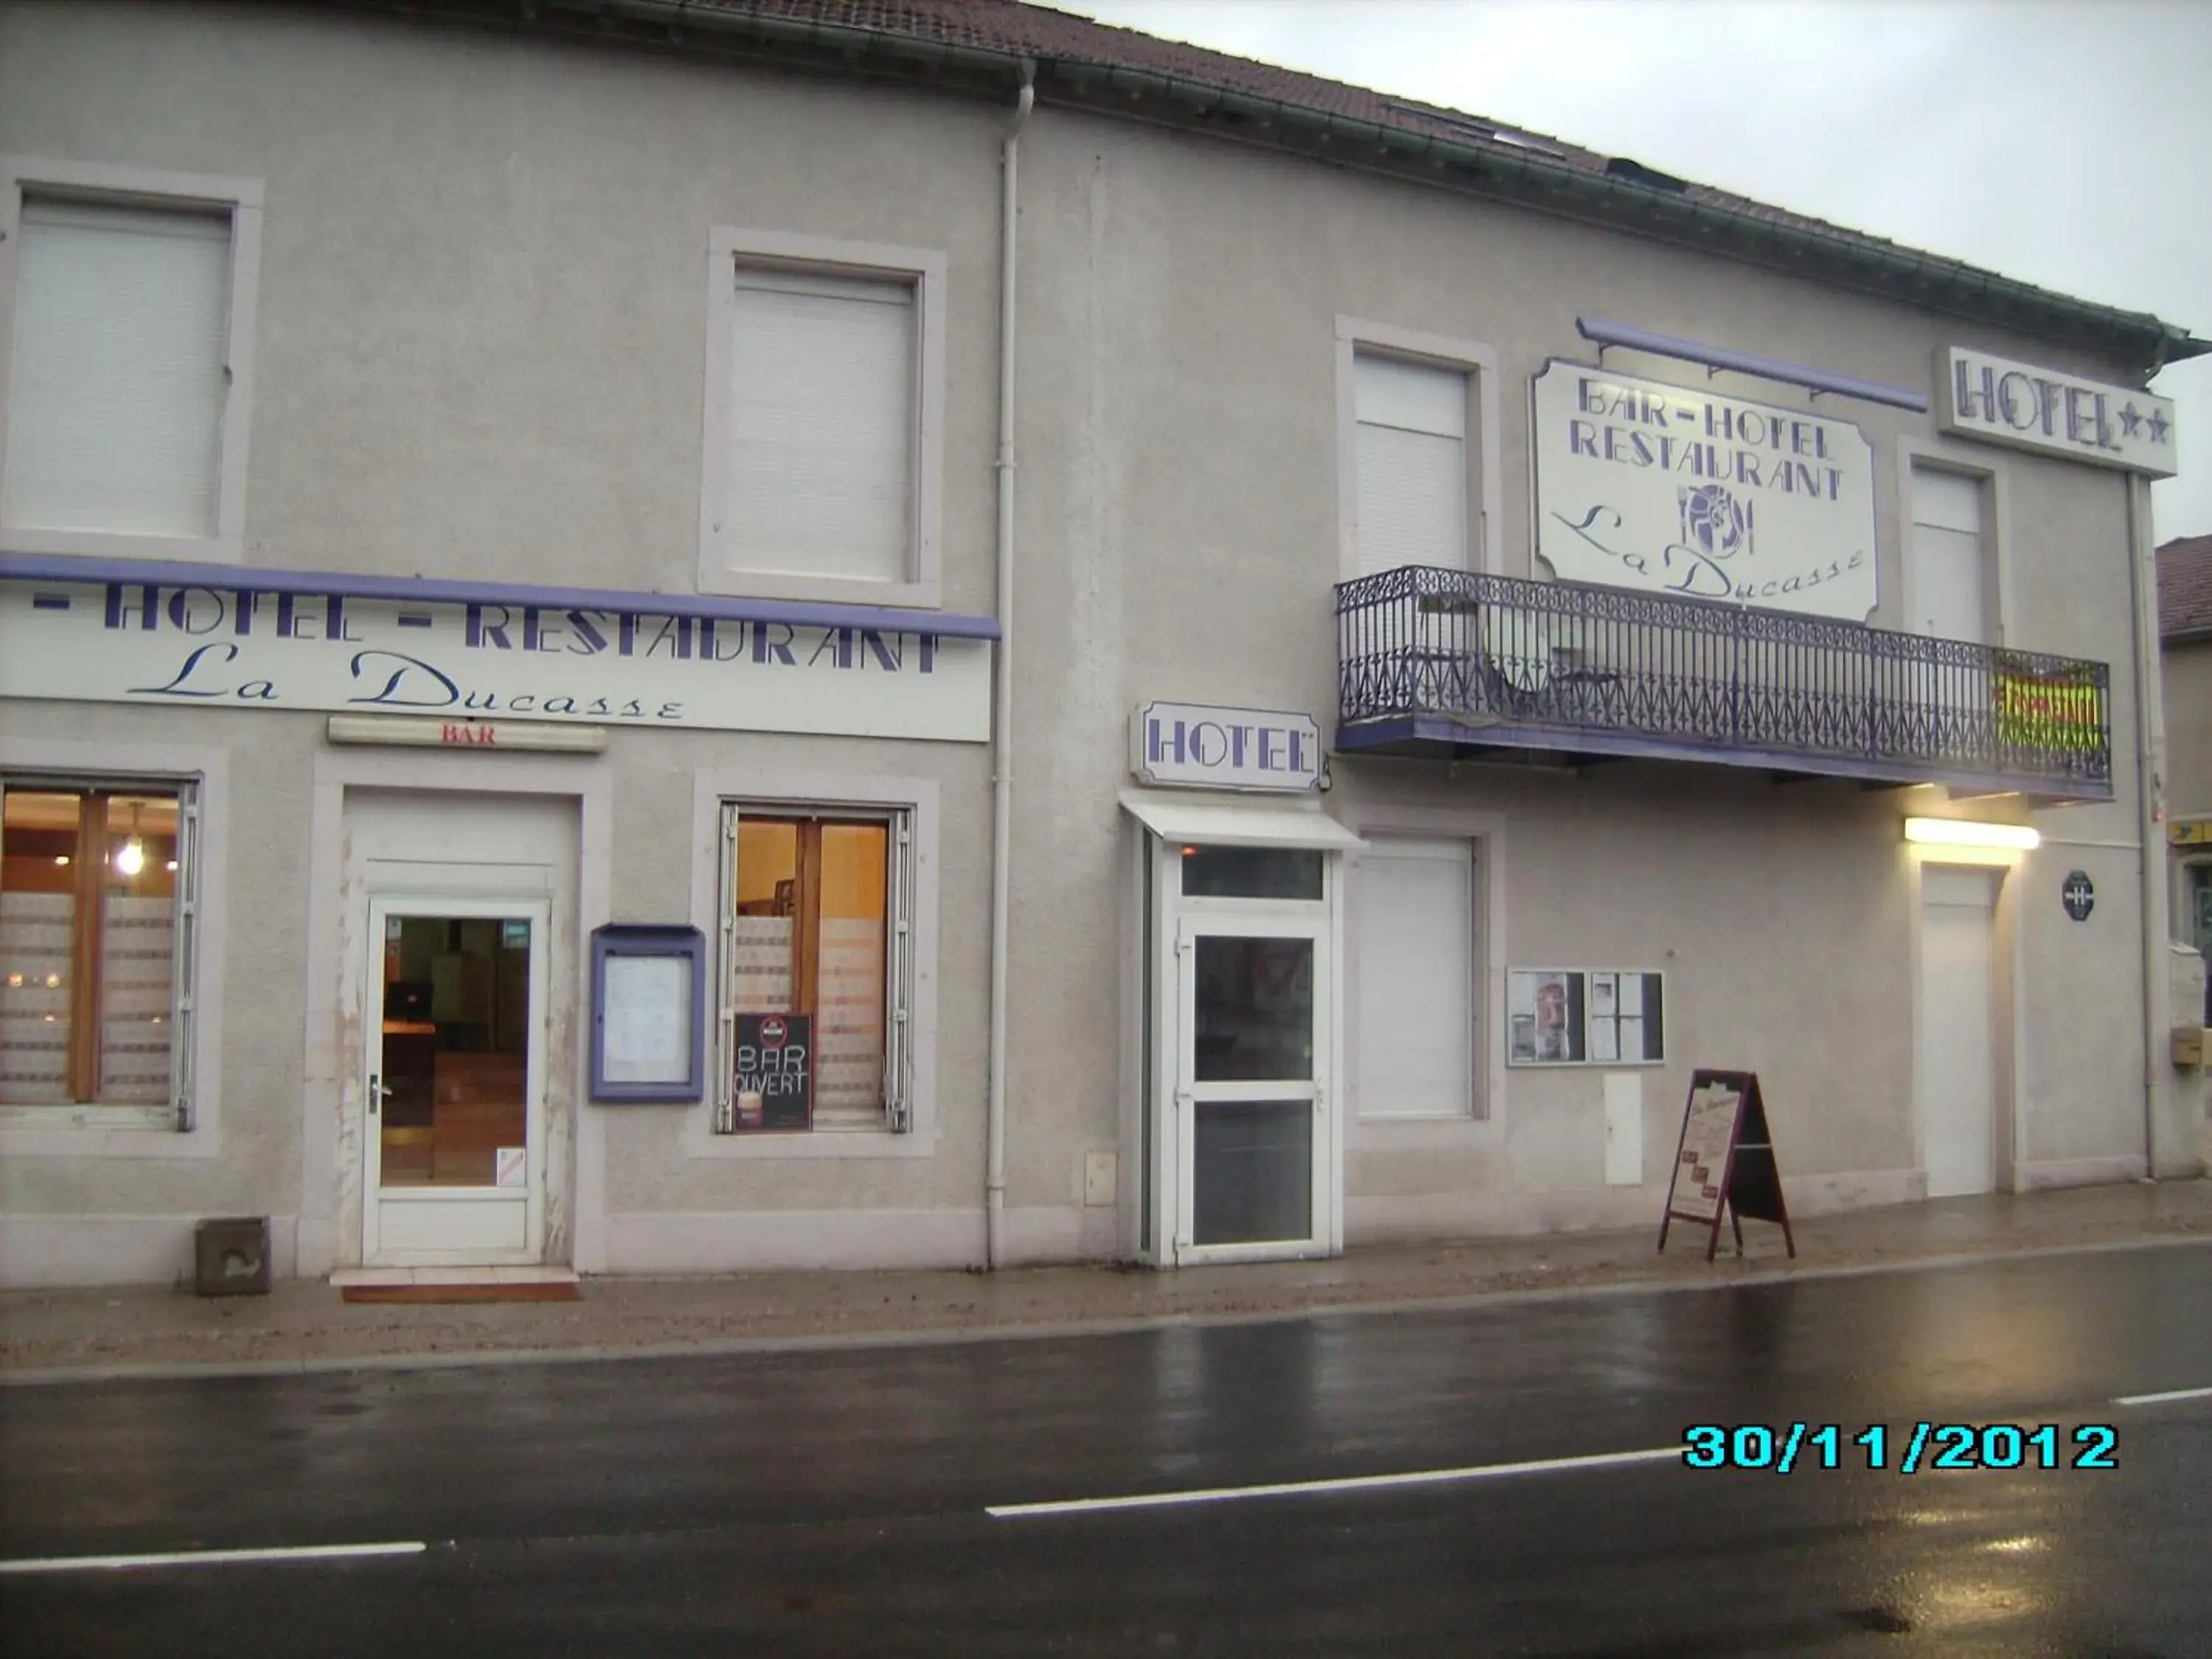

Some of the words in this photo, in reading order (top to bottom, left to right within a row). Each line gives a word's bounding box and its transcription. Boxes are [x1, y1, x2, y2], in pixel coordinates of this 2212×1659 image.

[1955, 359, 2123, 452] HOTEL
[1570, 420, 1844, 501] RESTAURANT
[1550, 505, 1649, 574] La
[1663, 543, 1865, 599] Ducasse
[104, 582, 364, 641] HOTEL
[465, 602, 940, 673] RESTAURANT
[125, 641, 279, 700] La
[347, 650, 684, 720] Ducasse
[442, 725, 495, 745] BAR
[1149, 719, 1315, 773] HOTEL
[737, 1045, 806, 1073] BAR
